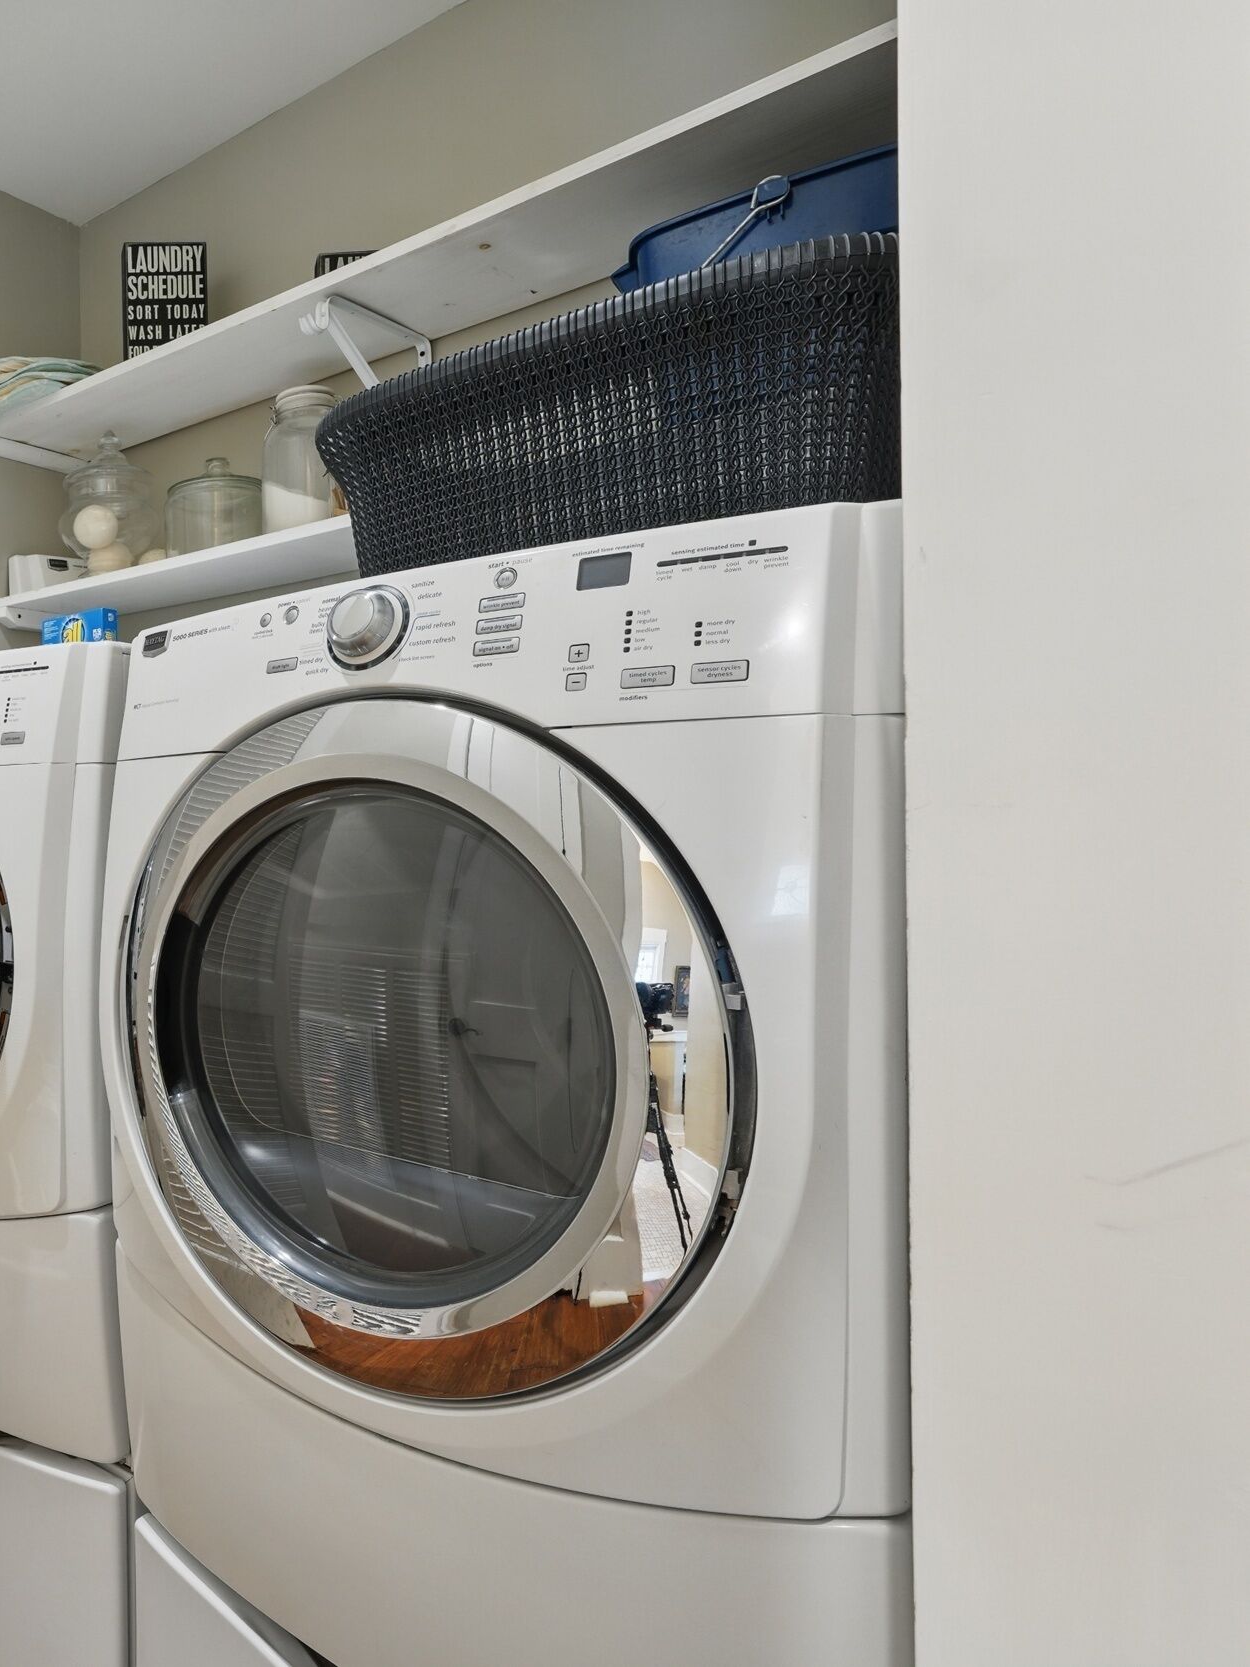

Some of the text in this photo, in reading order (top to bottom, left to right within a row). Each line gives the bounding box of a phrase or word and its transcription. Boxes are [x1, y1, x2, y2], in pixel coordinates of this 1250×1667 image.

[127, 245, 203, 273] LAUNDRY
[127, 274, 204, 300] SCHEDULE
[127, 303, 205, 320] SORT TODAY
[128, 325, 162, 340] WASH
[696, 543, 729, 553] estimated
[417, 591, 442, 600] delicate
[415, 620, 456, 631] rapid refresh
[188, 629, 209, 637] SERIES
[705, 629, 729, 637] normal
[408, 635, 456, 647] custom refresh
